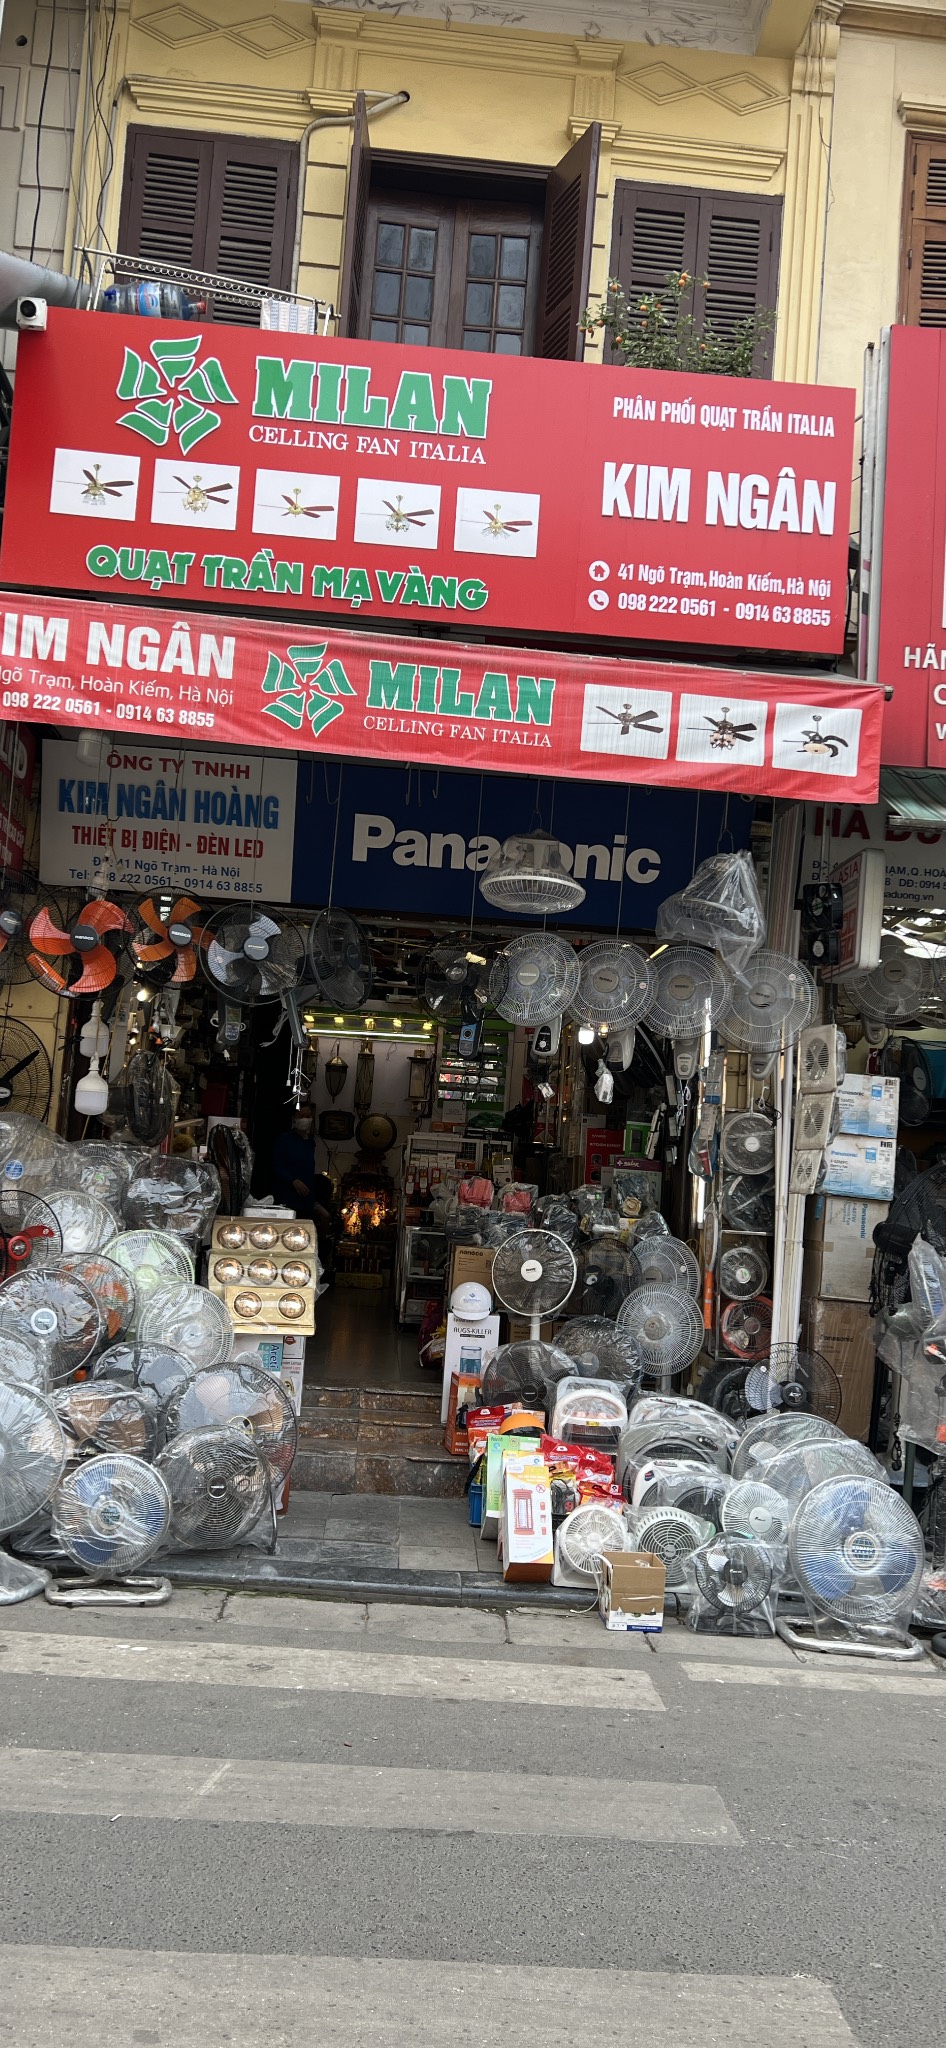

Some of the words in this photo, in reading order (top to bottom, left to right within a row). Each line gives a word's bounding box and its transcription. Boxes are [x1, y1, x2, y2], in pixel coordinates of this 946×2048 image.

[252, 355, 493, 439] MILAN
[613, 395, 656, 420] PHÂN
[661, 396, 696, 424] PHỐI
[700, 404, 737, 431] QUẠT
[742, 404, 783, 433] TRẦN
[787, 413, 836, 437] ITALIA
[249, 425, 349, 452] CELLING
[355, 436, 402, 457] FAN
[408, 440, 487, 465] ITALIA
[601, 461, 691, 523] KIM
[705, 467, 837, 536] NGÂN
[86, 545, 196, 591] QUẠT
[201, 548, 303, 595] TRẦN
[312, 564, 373, 610] MẠ
[375, 565, 489, 611] VÀNG
[617, 563, 634, 580] 41
[638, 564, 665, 585] Ngõ
[808, 579, 831, 600] Nội
[617, 592, 646, 611] 098
[648, 595, 678, 614] 222
[680, 597, 716, 617] 0561
[735, 602, 770, 622] 0914
[772, 605, 791, 624] 63
[793, 607, 832, 627] 8855
[0, 612, 69, 661] IM
[86, 621, 235, 679] NGÂN
[29, 669, 75, 690] Trạm,
[81, 675, 124, 694] Hoàn
[129, 680, 174, 700] Kiếm,
[179, 685, 201, 702] Hà
[206, 688, 233, 708] Nội
[366, 659, 557, 726] MILAN
[3, 691, 29, 707] 098
[33, 694, 61, 711] 222
[65, 697, 101, 716] 0561
[116, 703, 152, 722] 0914
[156, 708, 174, 723] 63
[178, 709, 215, 727] 8855
[363, 715, 445, 737] CELLING
[449, 723, 486, 742] FAN
[489, 727, 552, 748] ITALIA
[106, 750, 152, 772] ÔNG
[159, 757, 184, 774] TY
[192, 760, 251, 779] TNHH
[58, 779, 109, 816] KIM
[116, 780, 187, 821] NGÂN
[194, 786, 280, 830] HOÀNG
[72, 824, 116, 847] THIẾT
[121, 830, 137, 852] BỊ
[142, 828, 180, 856] ĐIỆN
[196, 832, 230, 856] ĐÈN
[234, 838, 264, 859] LED
[352, 812, 662, 884] Pananic
[69, 868, 90, 881] Tel:
[119, 872, 141, 885] 222
[144, 874, 172, 886] 0561
[184, 877, 213, 891] 0914
[216, 879, 231, 892] 63
[234, 881, 263, 894] 8855
[134, 858, 157, 873] Ngõ
[161, 862, 190, 875] Trạm
[202, 864, 218, 876] Hà
[221, 866, 240, 879] Nội
[884, 890, 934, 903] aduong.vn
[860, 1203, 868, 1239] Panasonic
